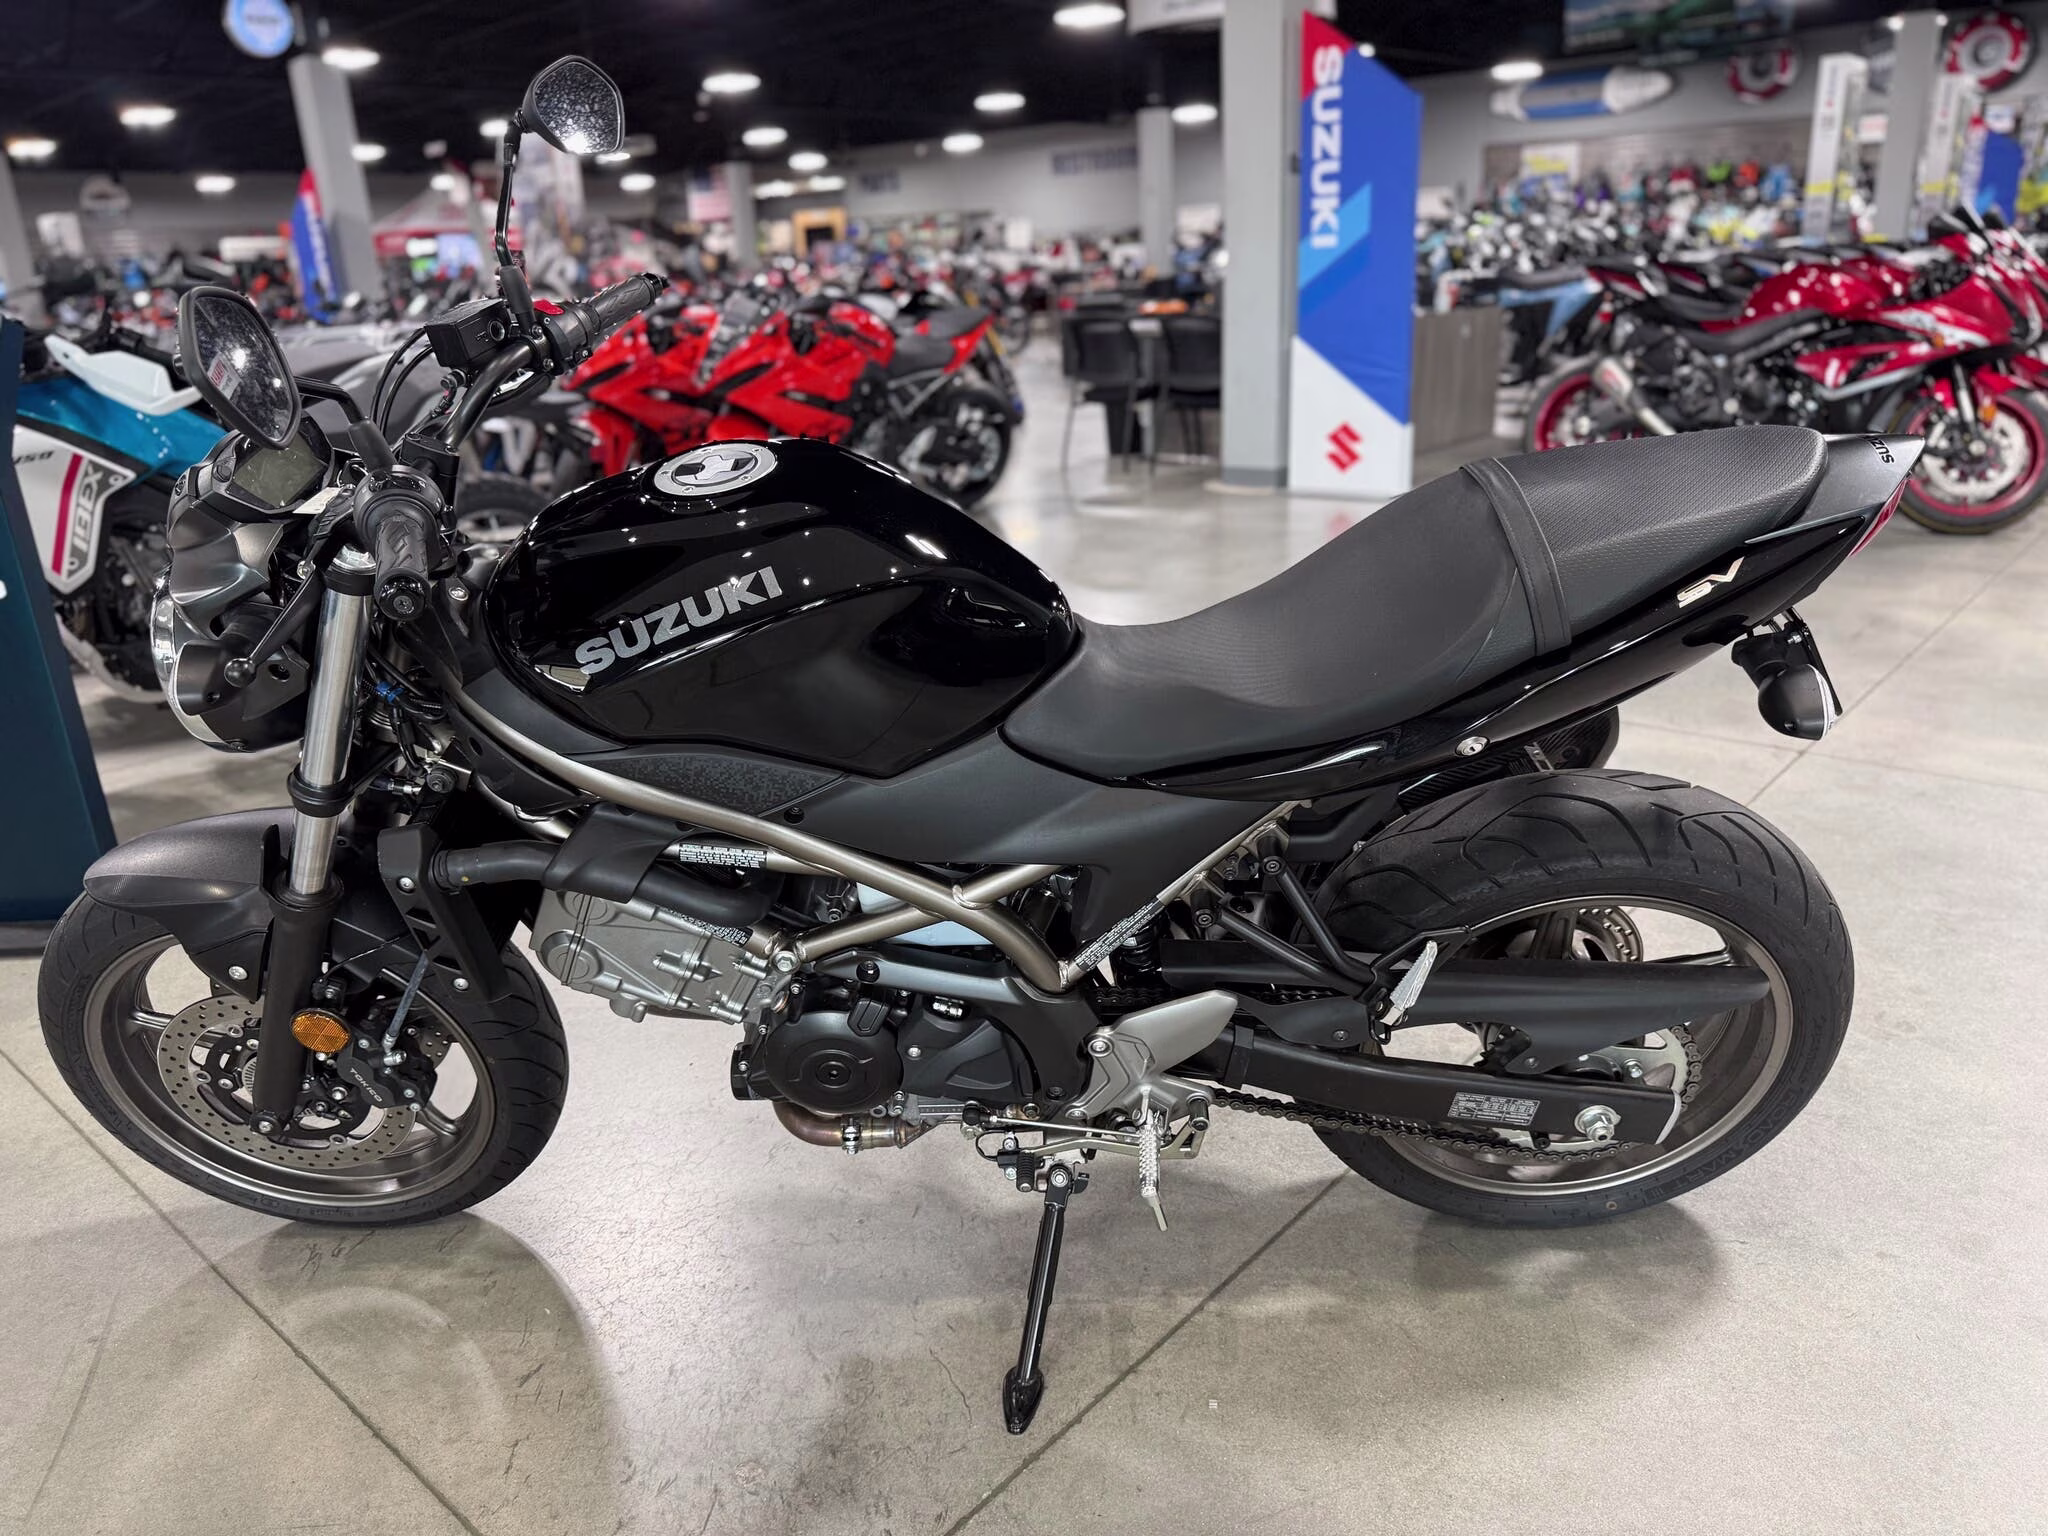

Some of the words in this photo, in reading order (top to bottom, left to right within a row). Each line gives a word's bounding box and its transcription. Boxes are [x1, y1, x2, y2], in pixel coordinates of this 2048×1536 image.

[1310, 44, 1344, 248] SUZUKI
[73, 463, 104, 552] IBEX
[575, 566, 783, 675] SUZUKI
[1677, 556, 1745, 608] SV
[350, 1067, 383, 1102] TOKICO
